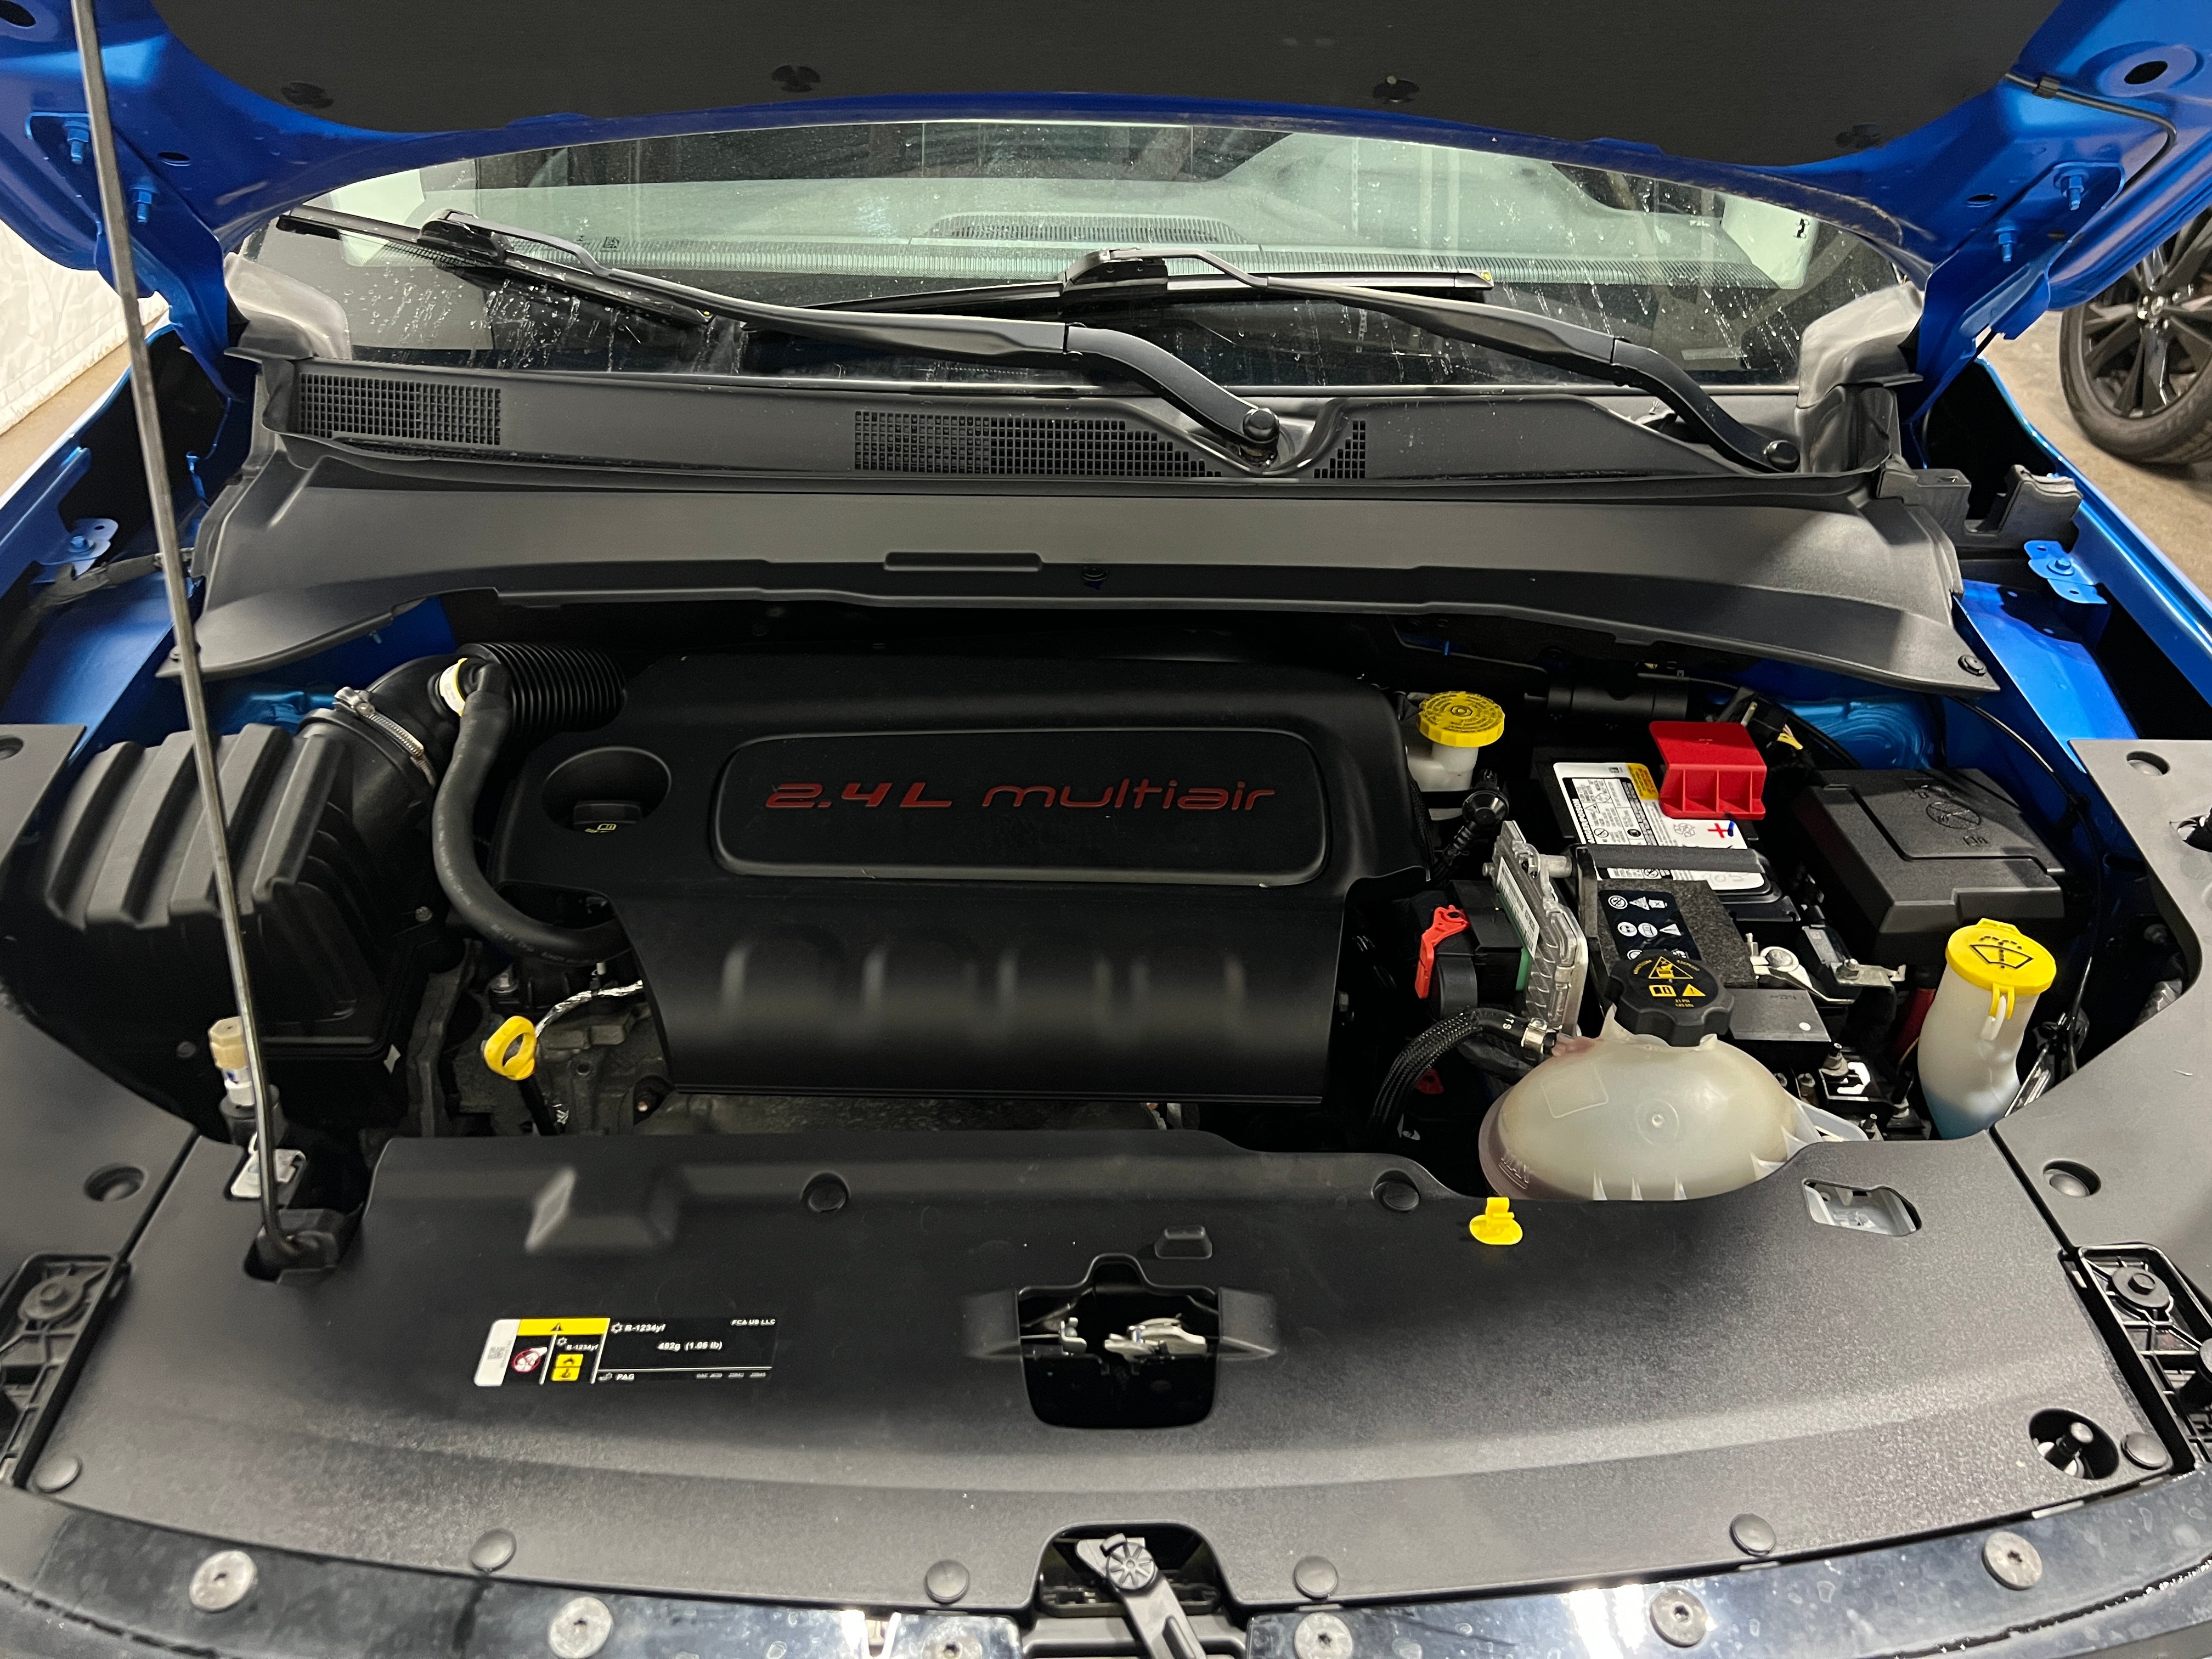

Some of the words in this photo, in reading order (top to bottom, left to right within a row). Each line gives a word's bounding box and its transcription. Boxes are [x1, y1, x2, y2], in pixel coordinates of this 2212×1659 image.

[982, 778, 1275, 810] multiair
[624, 1323, 666, 1333] R-1234yf
[684, 1341, 708, 1351] (1.06
[709, 1341, 723, 1350] lb)
